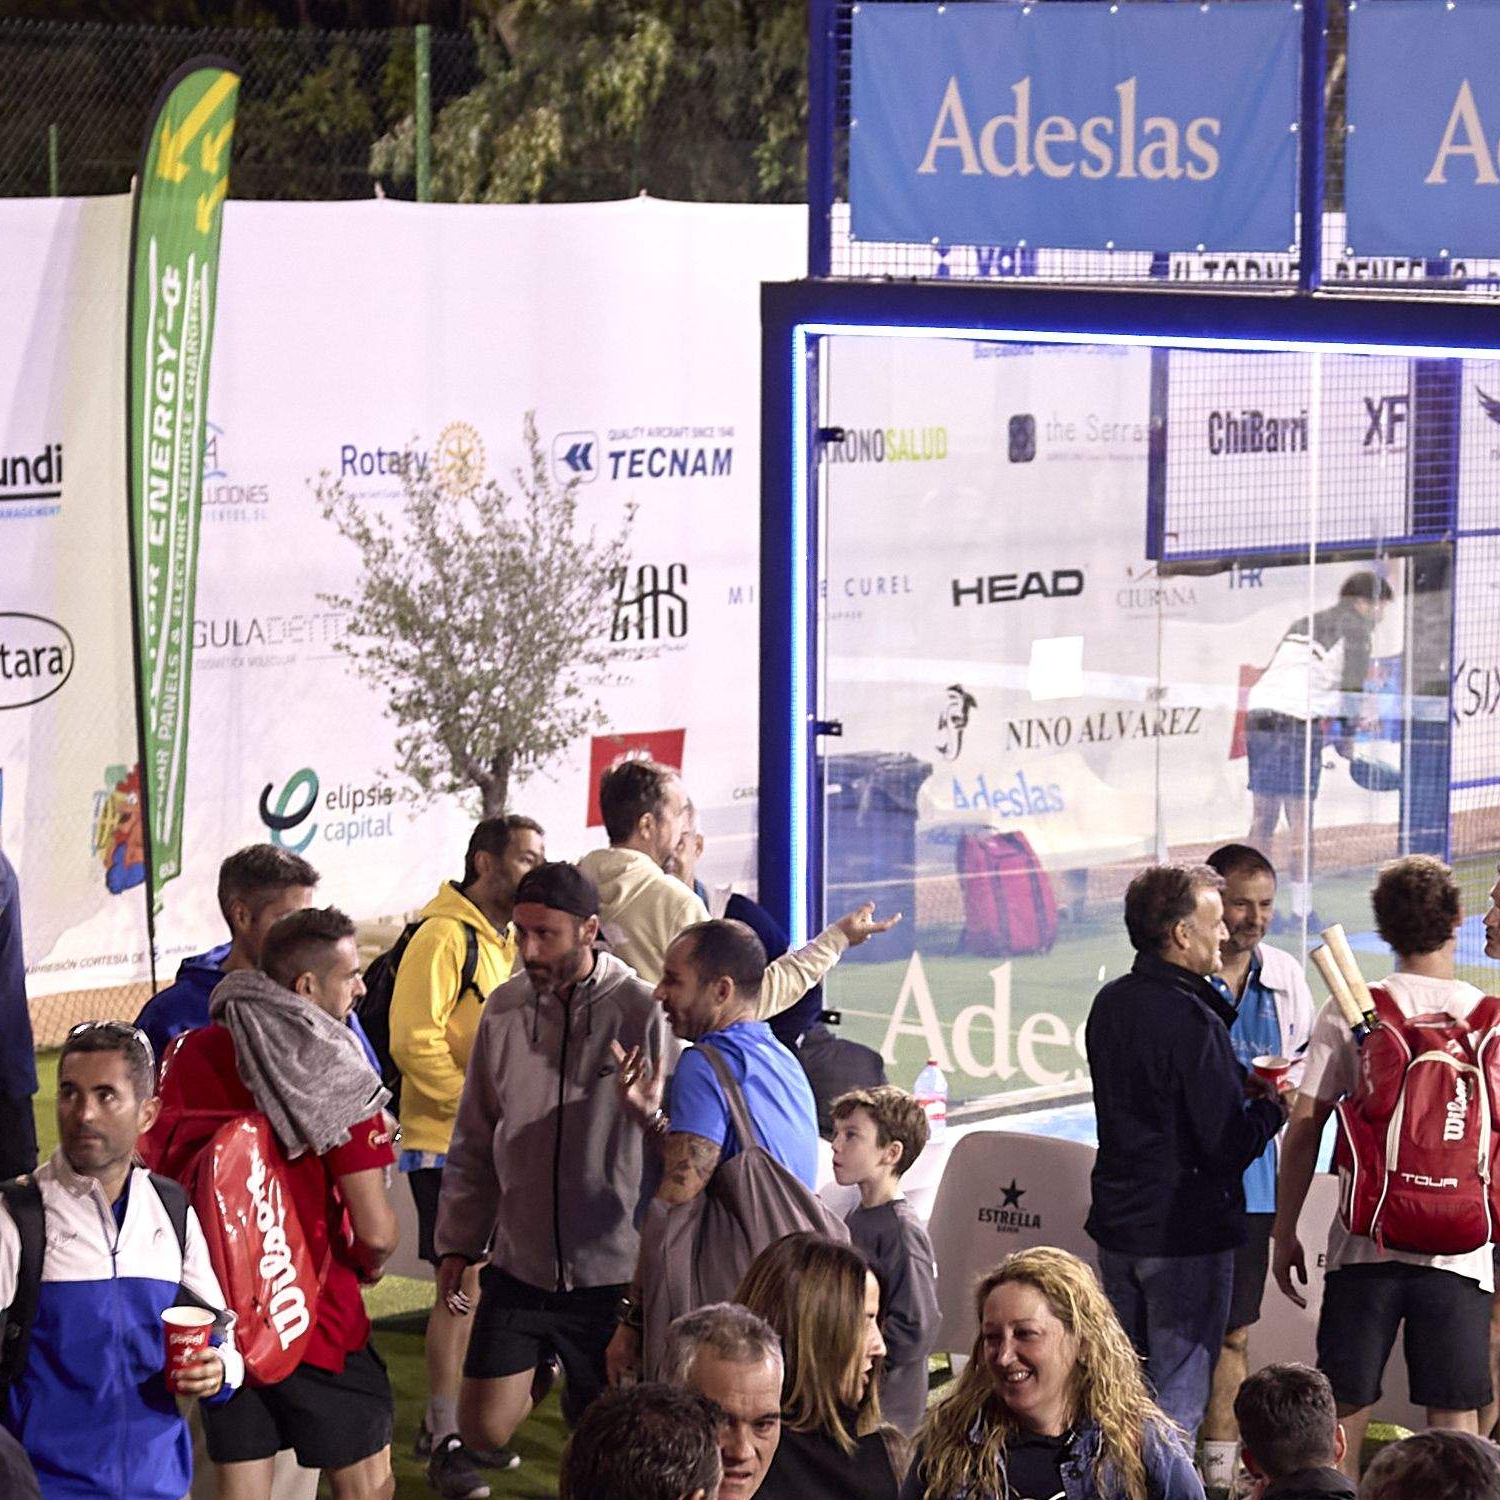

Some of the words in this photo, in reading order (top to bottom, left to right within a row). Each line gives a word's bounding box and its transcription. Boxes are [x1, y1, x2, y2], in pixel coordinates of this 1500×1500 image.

[917, 75, 1221, 181] Adeslas
[147, 334, 179, 546] ENERGY
[1047, 414, 1079, 442] the
[1208, 409, 1309, 455] ChiBarri
[341, 444, 428, 480] Rotay
[609, 448, 734, 480] TECNAM
[201, 484, 269, 506] LUCIONES
[157, 654, 180, 741] PANELS
[177, 410, 194, 503] VEHICLE
[845, 574, 913, 597] CUREL
[952, 569, 1085, 607] HEAD
[1007, 715, 1072, 751] NINO
[1077, 706, 1201, 744] ALVAREZ
[326, 785, 394, 812] elipsis
[324, 814, 394, 842] capital
[1443, 1076, 1469, 1142] Wilson
[1401, 1172, 1459, 1188] TOUR
[978, 1207, 1041, 1229] ESTRELLA
[246, 1140, 311, 1351] Wilson
